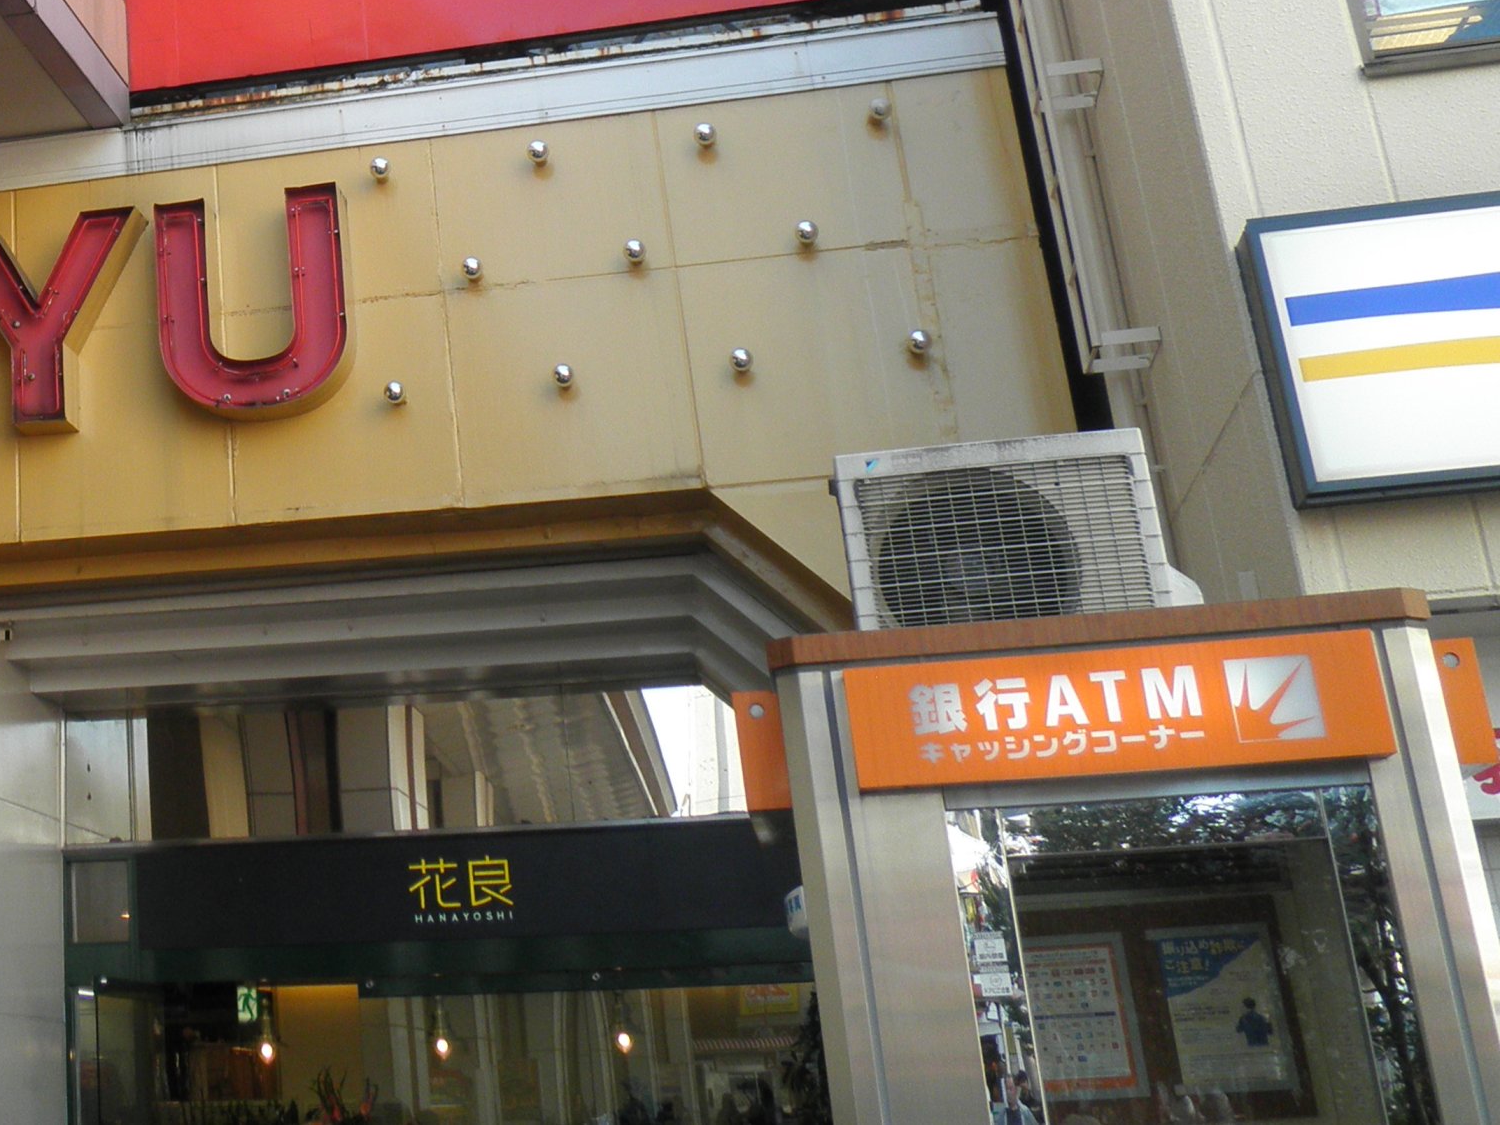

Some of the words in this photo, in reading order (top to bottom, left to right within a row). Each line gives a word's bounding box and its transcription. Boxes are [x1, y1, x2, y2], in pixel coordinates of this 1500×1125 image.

[907, 665, 1202, 735] 銀行ATM
[919, 723, 1205, 764] キャッシングコーナー
[408, 854, 514, 910] 花良
[414, 910, 513, 924] HANAYOSHI
